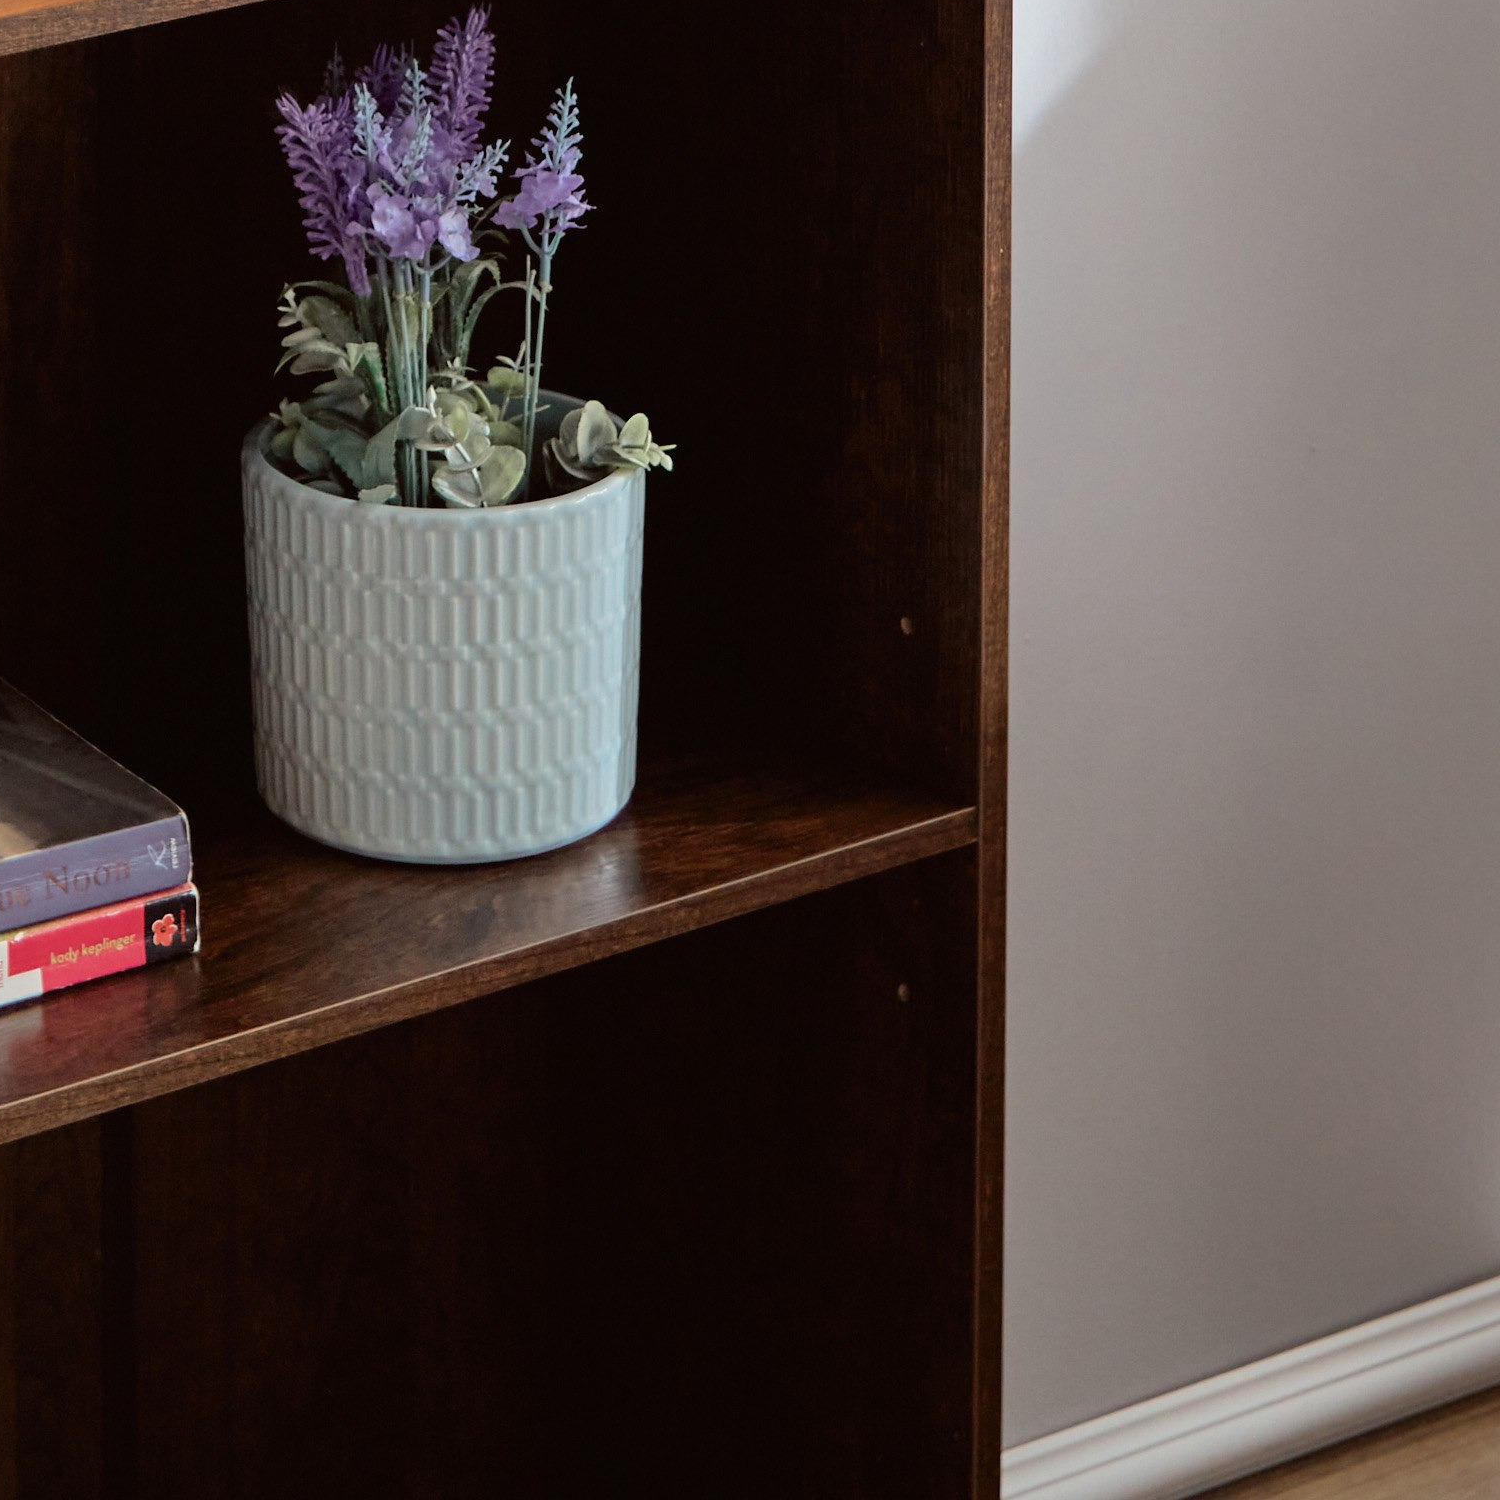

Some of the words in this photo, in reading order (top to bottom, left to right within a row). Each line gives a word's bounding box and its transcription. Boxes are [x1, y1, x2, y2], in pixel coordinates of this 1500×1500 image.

[43, 859, 131, 899] Noon
[50, 942, 80, 967] kady
[81, 932, 136, 958] keplinger
